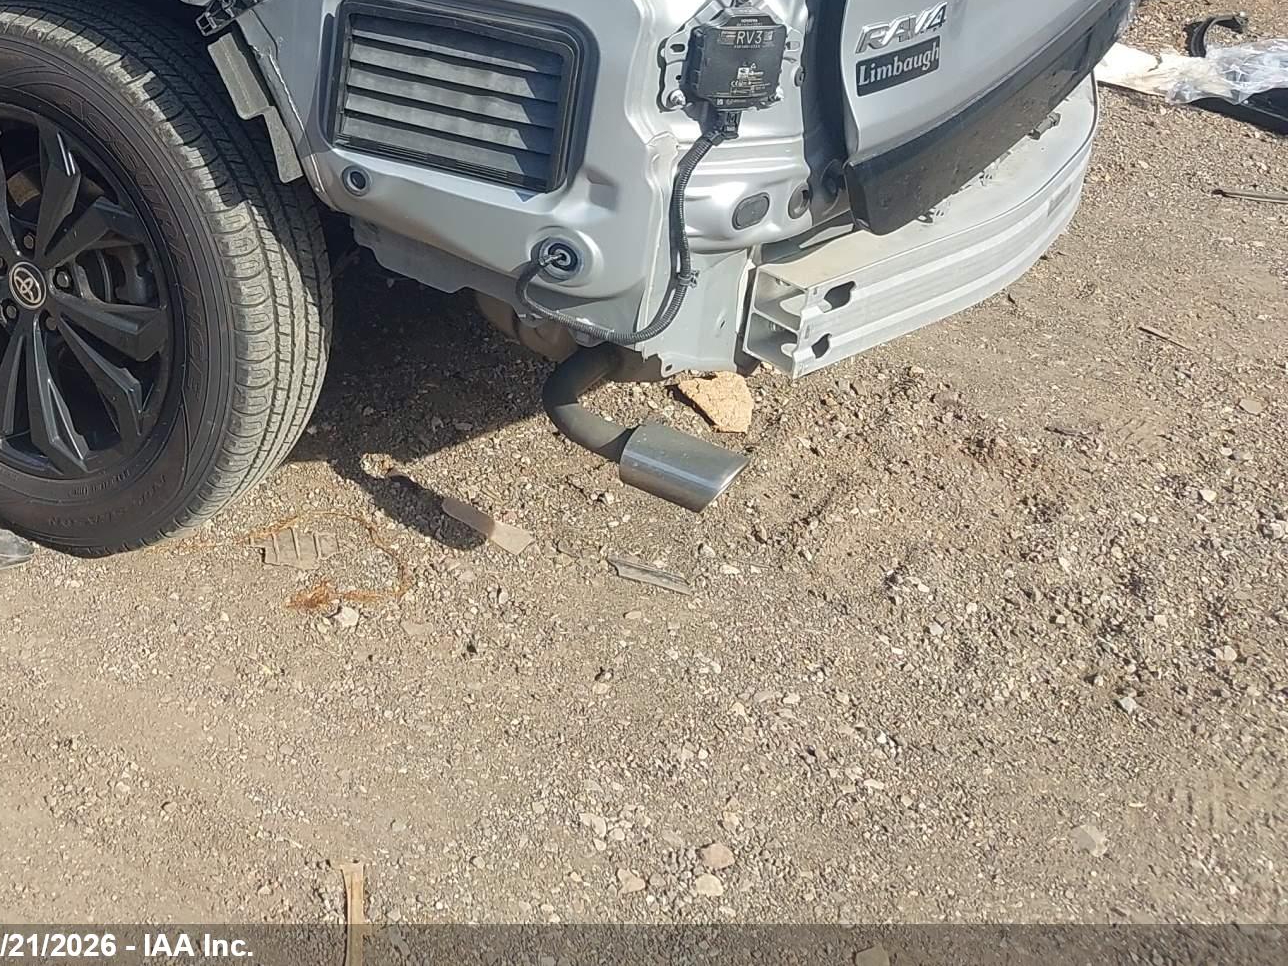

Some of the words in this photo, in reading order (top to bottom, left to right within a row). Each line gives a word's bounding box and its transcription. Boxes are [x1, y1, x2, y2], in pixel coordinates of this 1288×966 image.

[736, 30, 763, 45] RV3
[854, 0, 948, 55] RAV4
[857, 41, 939, 86] Limbaugh
